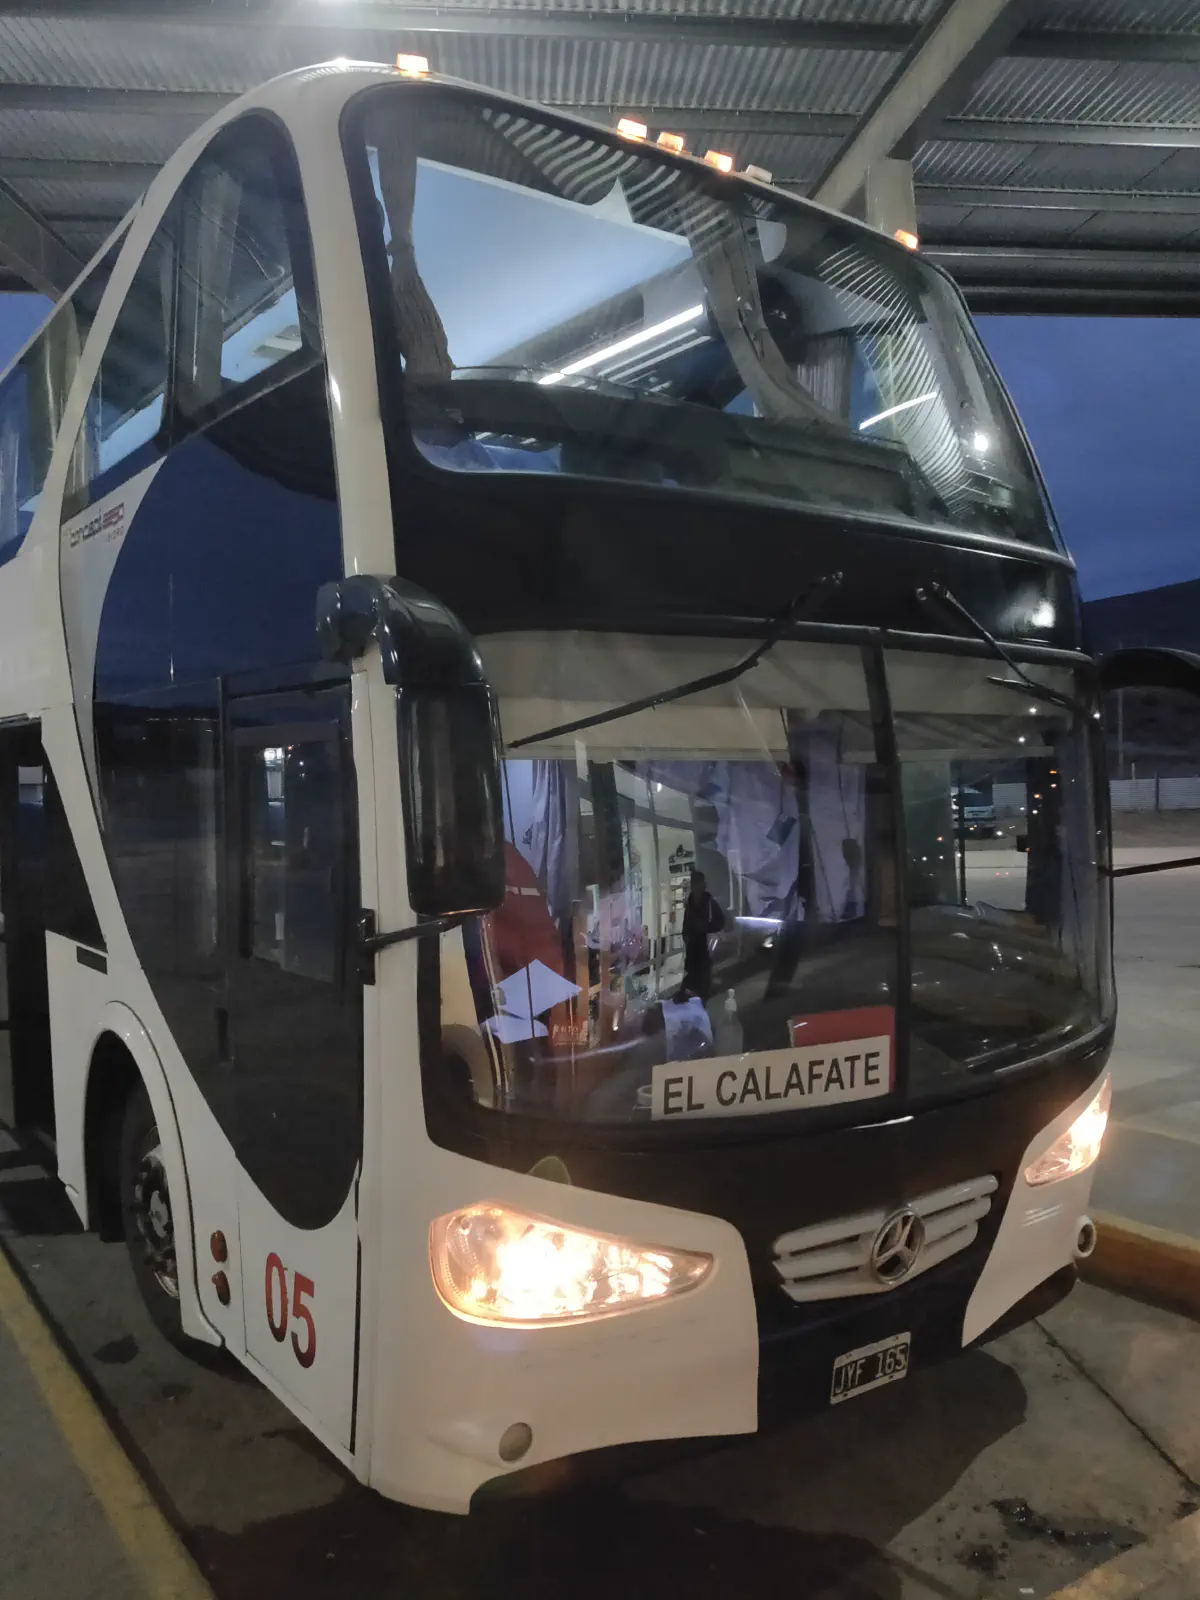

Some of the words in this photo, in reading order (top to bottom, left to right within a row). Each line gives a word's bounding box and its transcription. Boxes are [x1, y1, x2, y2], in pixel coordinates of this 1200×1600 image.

[664, 1076, 704, 1115] EL
[716, 1052, 880, 1106] CALAFATE
[265, 1252, 316, 1369] 05
[835, 1358, 866, 1393] JYF
[875, 1344, 906, 1378] 165
